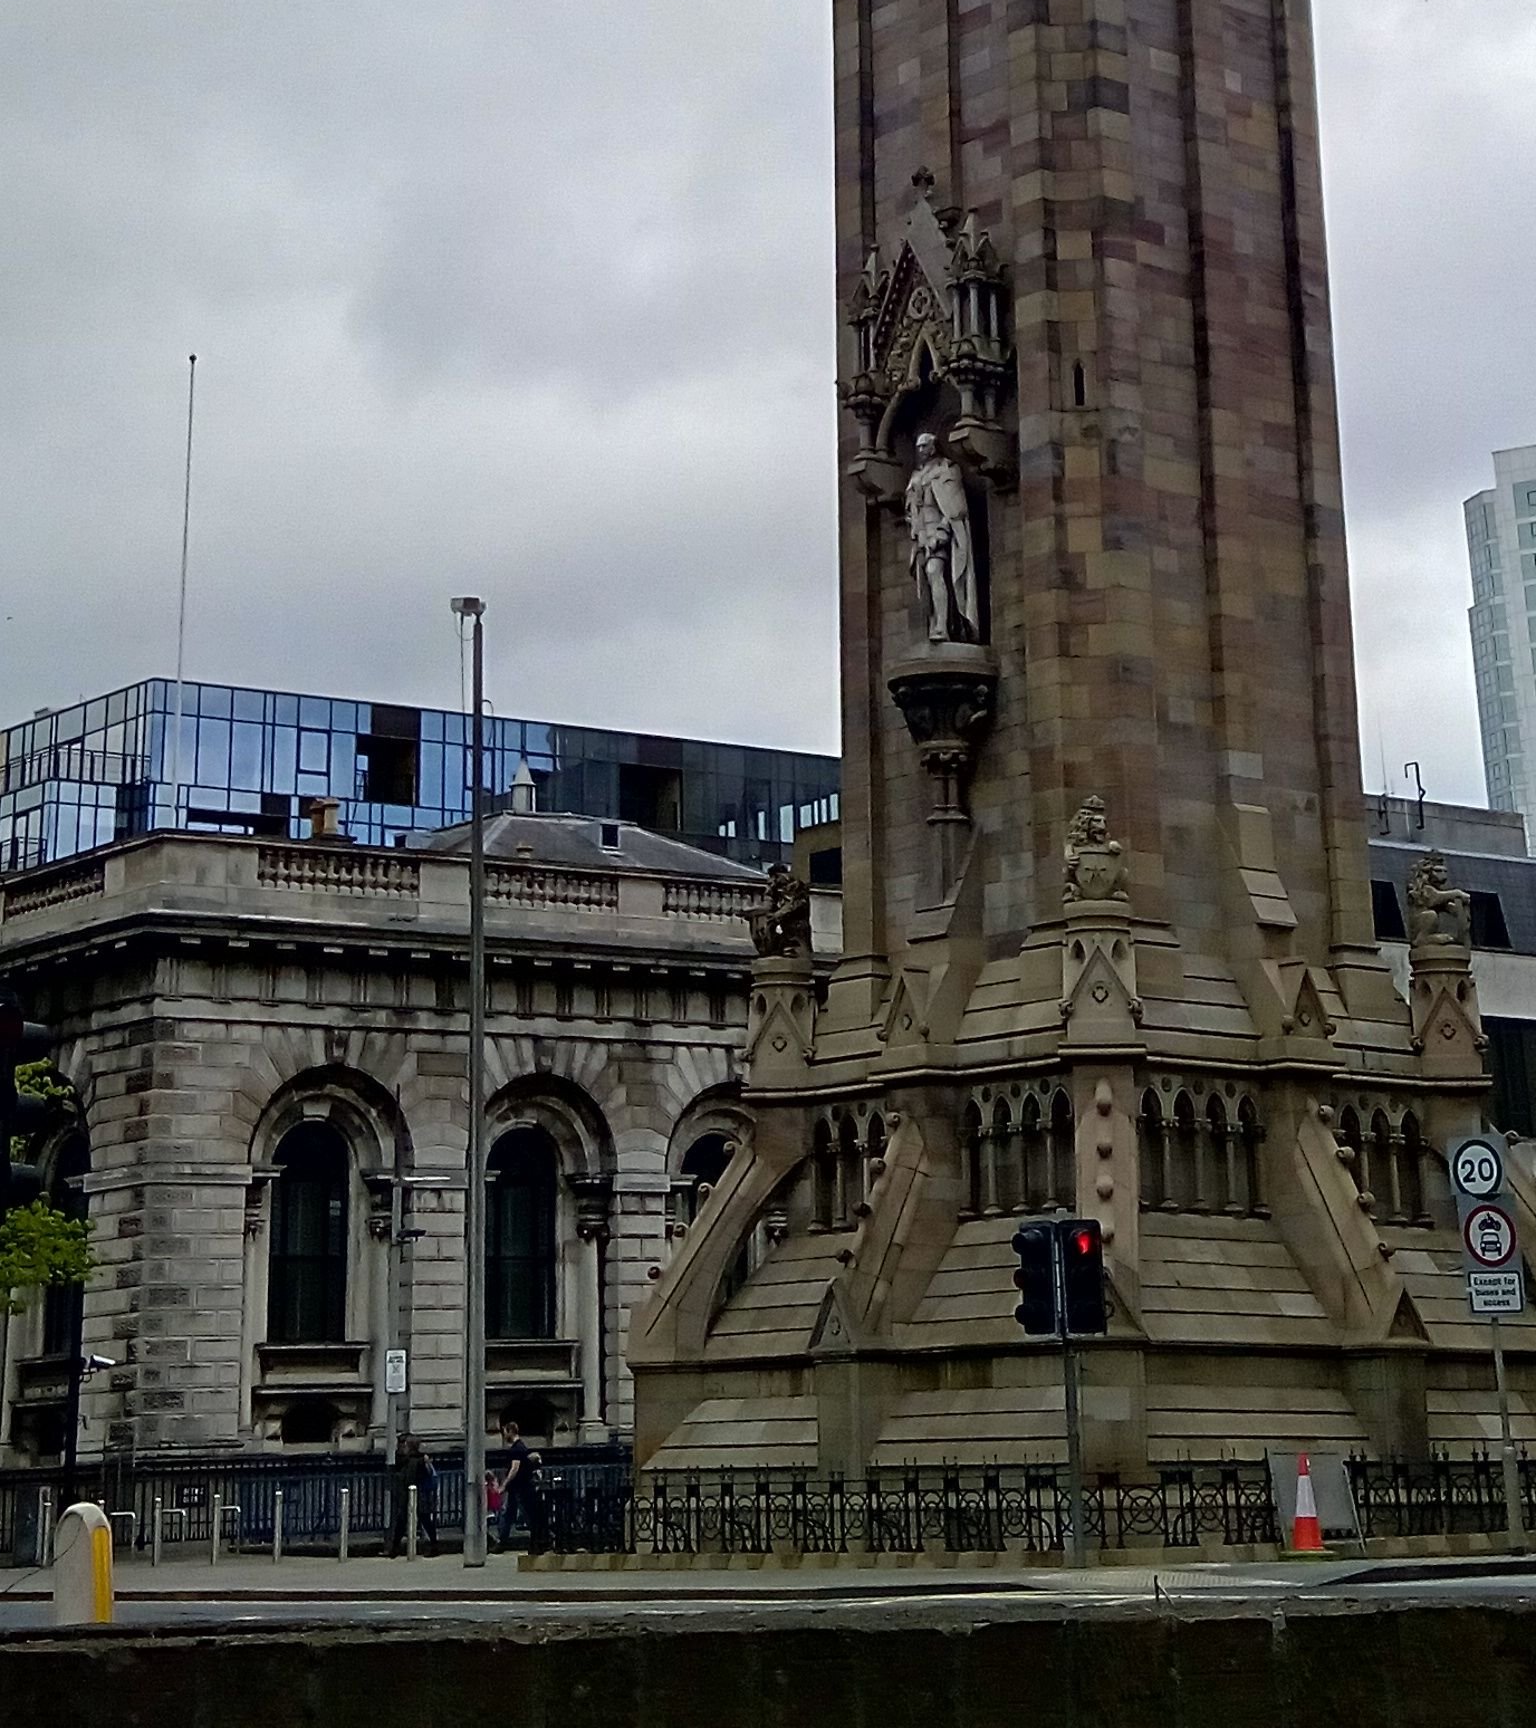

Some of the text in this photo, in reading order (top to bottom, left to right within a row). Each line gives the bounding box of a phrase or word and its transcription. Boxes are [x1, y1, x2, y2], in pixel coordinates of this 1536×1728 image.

[1460, 1157, 1495, 1183] 20
[1474, 1276, 1516, 1286] Except for
[1475, 1288, 1516, 1297] buses and
